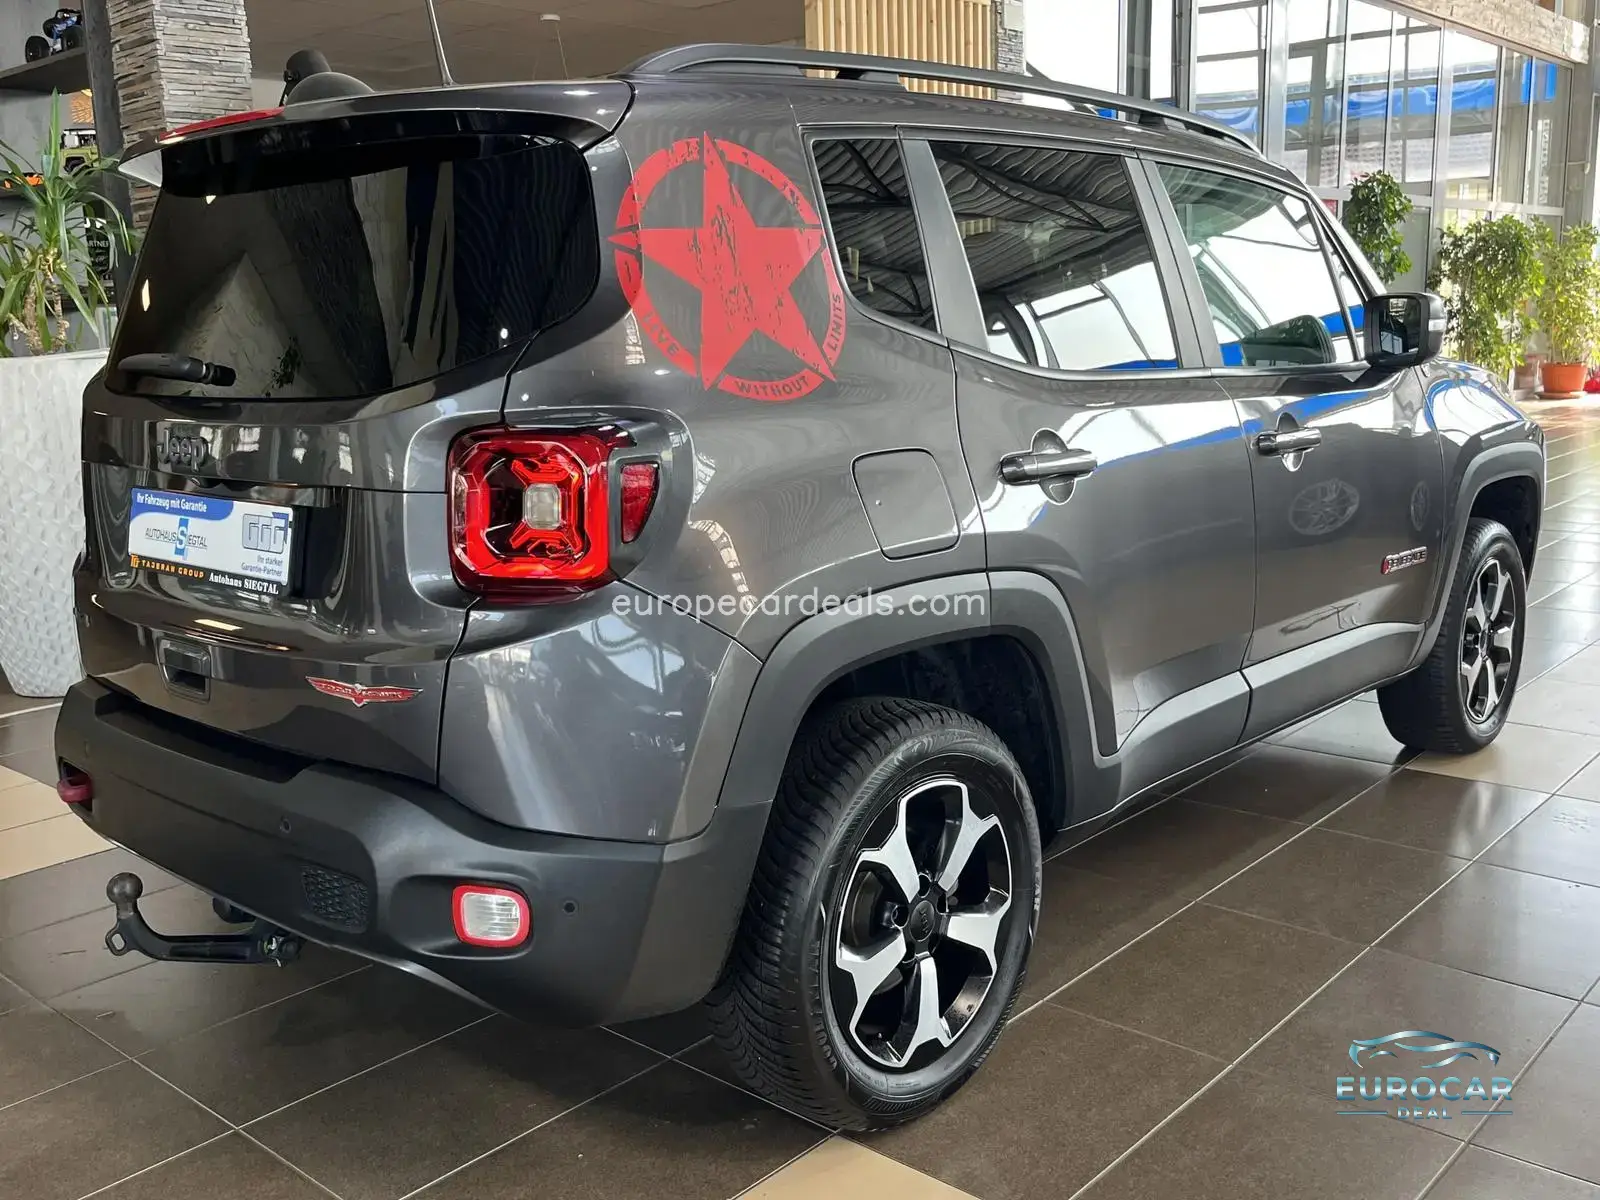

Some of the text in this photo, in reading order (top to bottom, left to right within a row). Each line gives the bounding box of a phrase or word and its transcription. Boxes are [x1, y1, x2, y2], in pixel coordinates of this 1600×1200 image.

[829, 293, 845, 352] LIMITS
[734, 375, 810, 398] WITHOUT
[156, 429, 207, 471] Jeep
[136, 492, 207, 513] Ihr Fahrzeug mit Garantie
[145, 527, 177, 543] AUTOHAUS
[178, 567, 204, 578] GROUP
[208, 572, 242, 588] Autohaus
[243, 578, 279, 595] SIEGTAL
